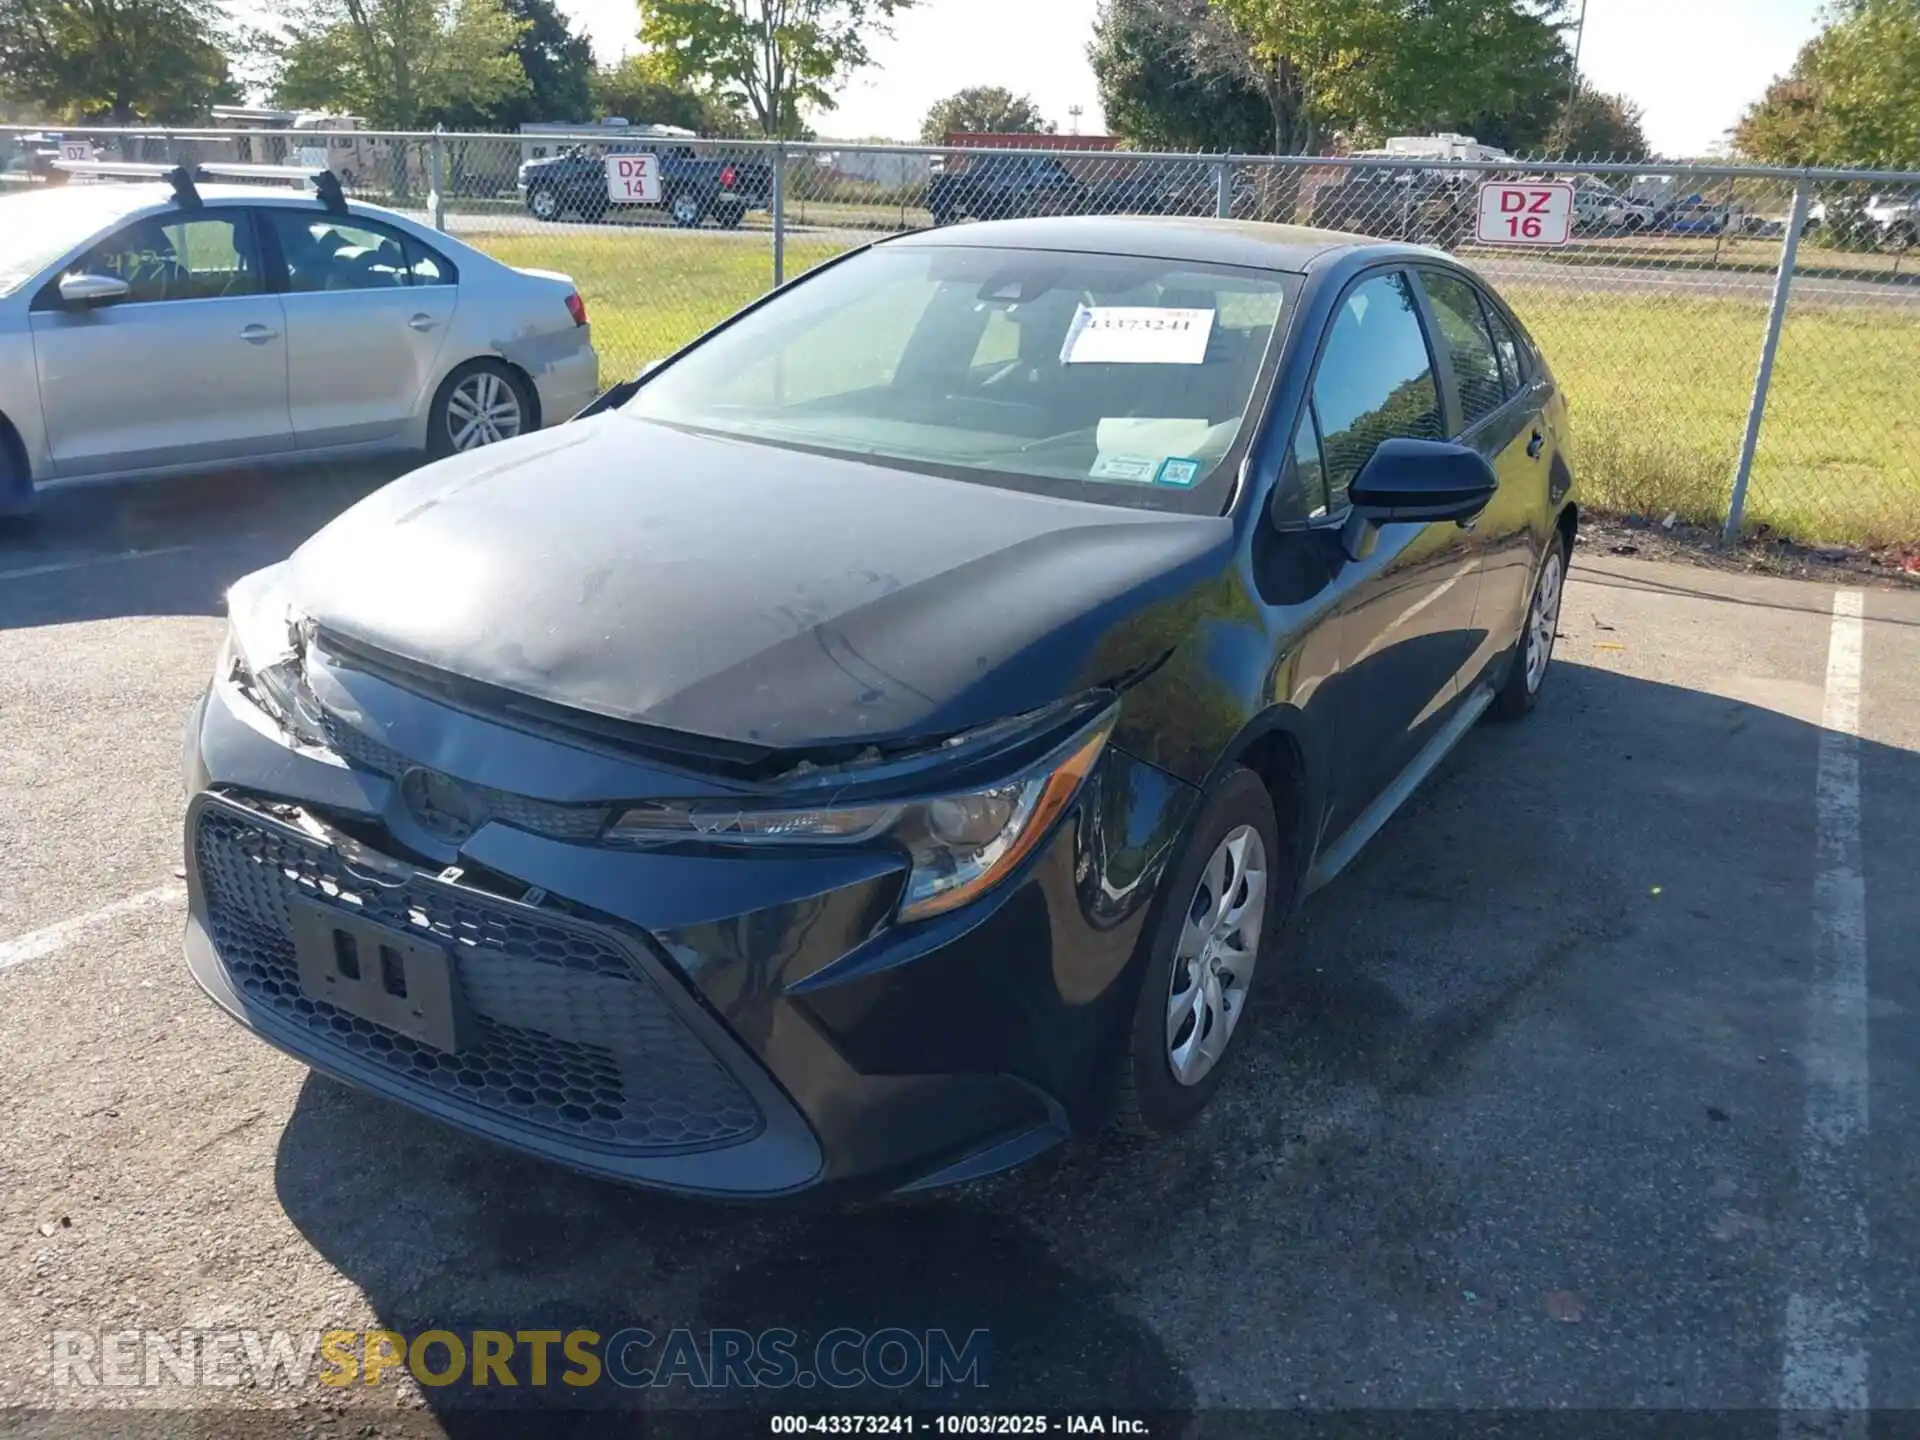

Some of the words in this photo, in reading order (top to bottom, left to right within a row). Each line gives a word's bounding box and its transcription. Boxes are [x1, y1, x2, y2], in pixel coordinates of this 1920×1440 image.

[67, 147, 85, 160] DZ
[619, 161, 646, 177] DZ
[624, 180, 643, 196] 14
[1501, 191, 1551, 213] DZ
[1506, 217, 1541, 237] 16
